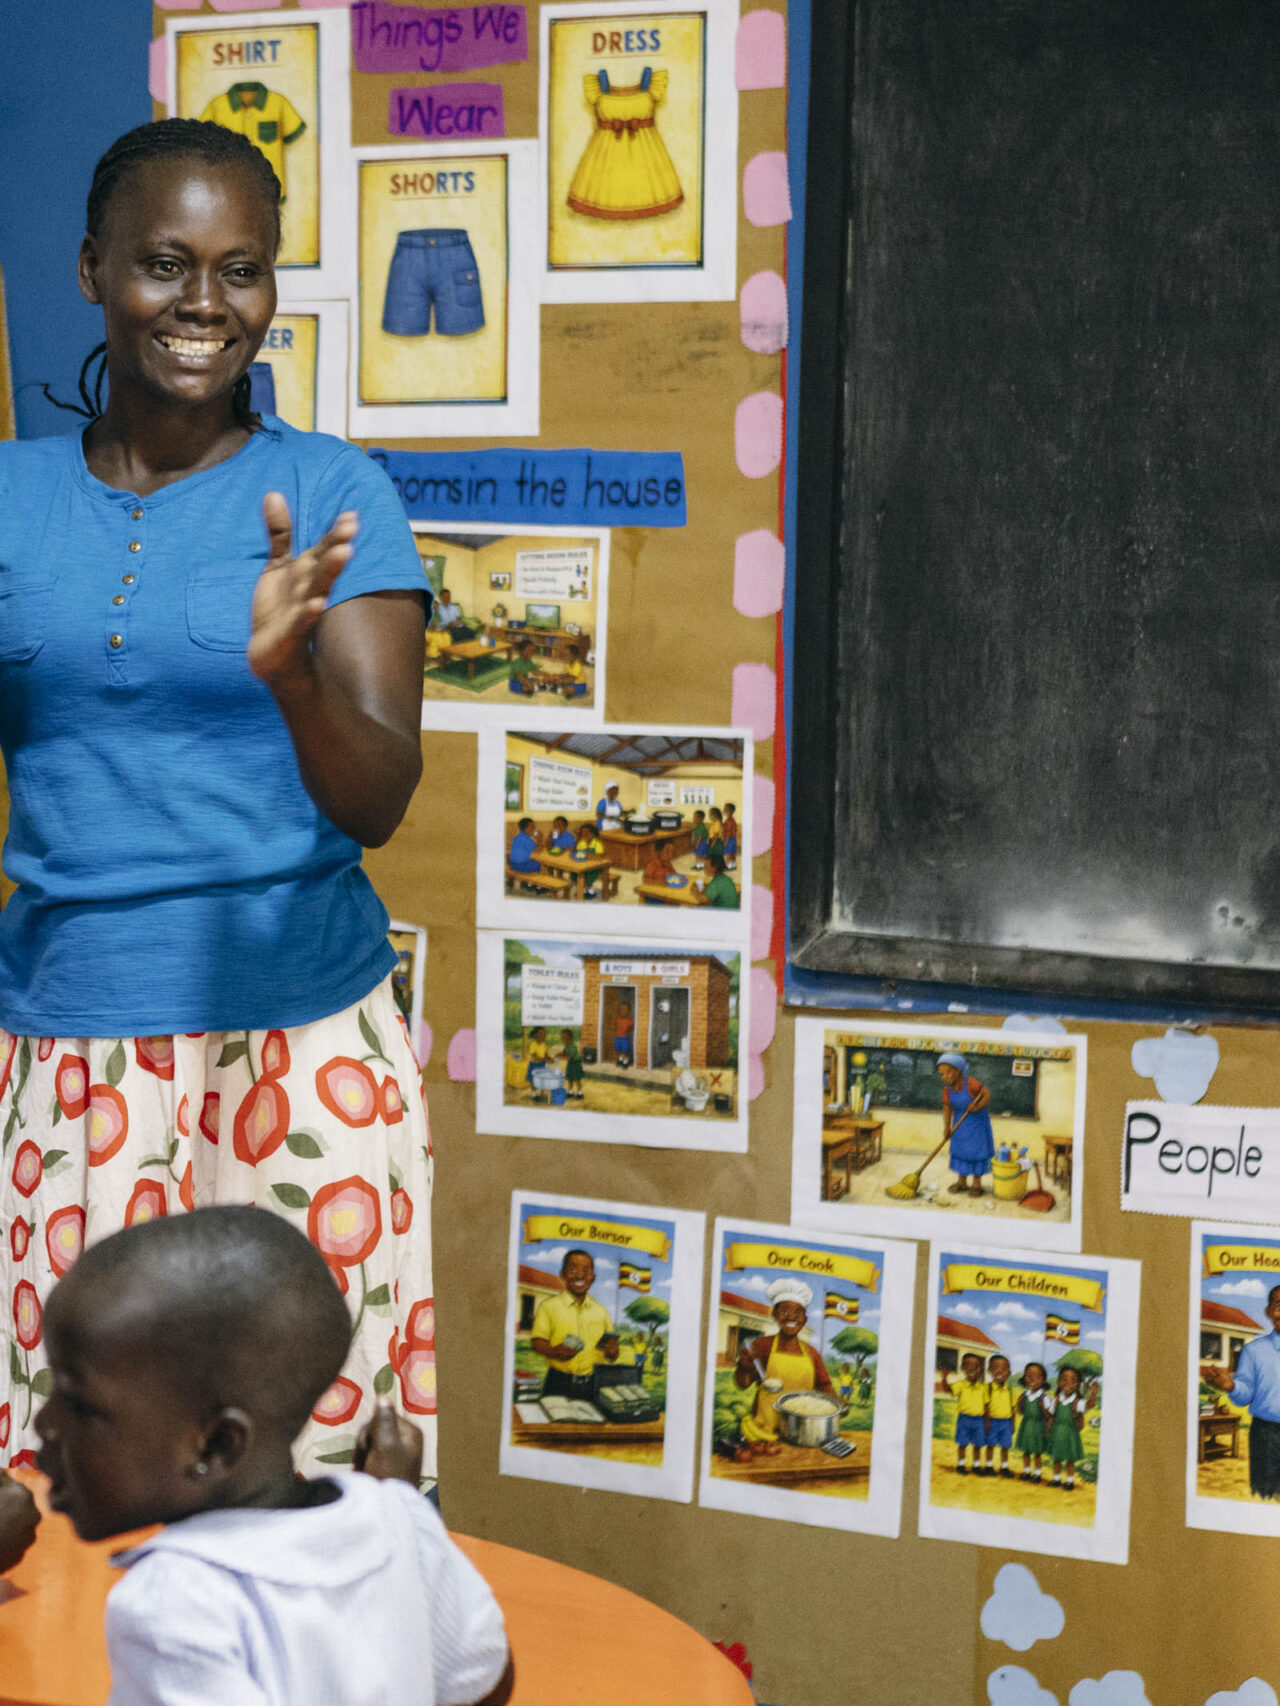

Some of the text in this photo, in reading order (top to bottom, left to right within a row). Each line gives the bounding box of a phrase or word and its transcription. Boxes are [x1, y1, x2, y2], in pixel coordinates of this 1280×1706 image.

[351, 4, 520, 72] Things We
[591, 28, 662, 55] DRESS
[212, 40, 281, 65] SHIRT
[396, 95, 500, 134] Wear
[389, 171, 475, 196] SHORTS
[516, 461, 566, 507] the
[583, 455, 681, 508] house
[1124, 1112, 1263, 1198] People
[558, 1222, 633, 1246] Our Bursar
[766, 1251, 835, 1273] Our Cook
[1219, 1251, 1248, 1267] Our
[975, 1271, 1069, 1296] Our Children
